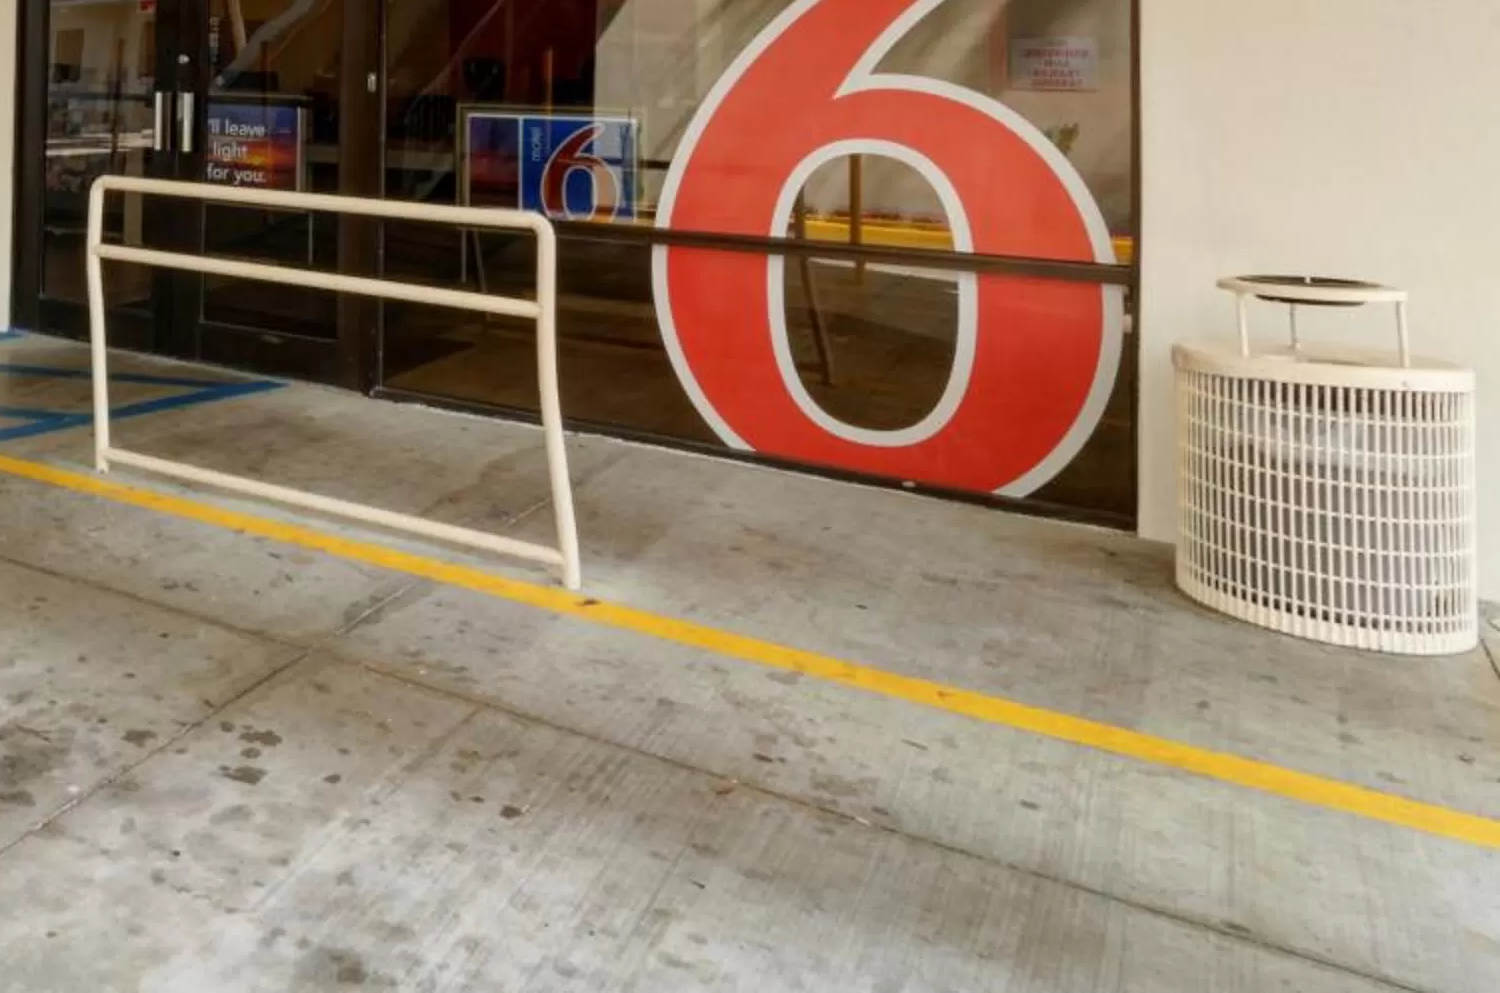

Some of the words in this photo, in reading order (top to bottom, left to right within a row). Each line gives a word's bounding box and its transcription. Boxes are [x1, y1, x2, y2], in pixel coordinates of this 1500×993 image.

[225, 118, 265, 137] leave
[213, 140, 248, 162] light
[207, 162, 230, 180] for
[541, 122, 621, 224] 6
